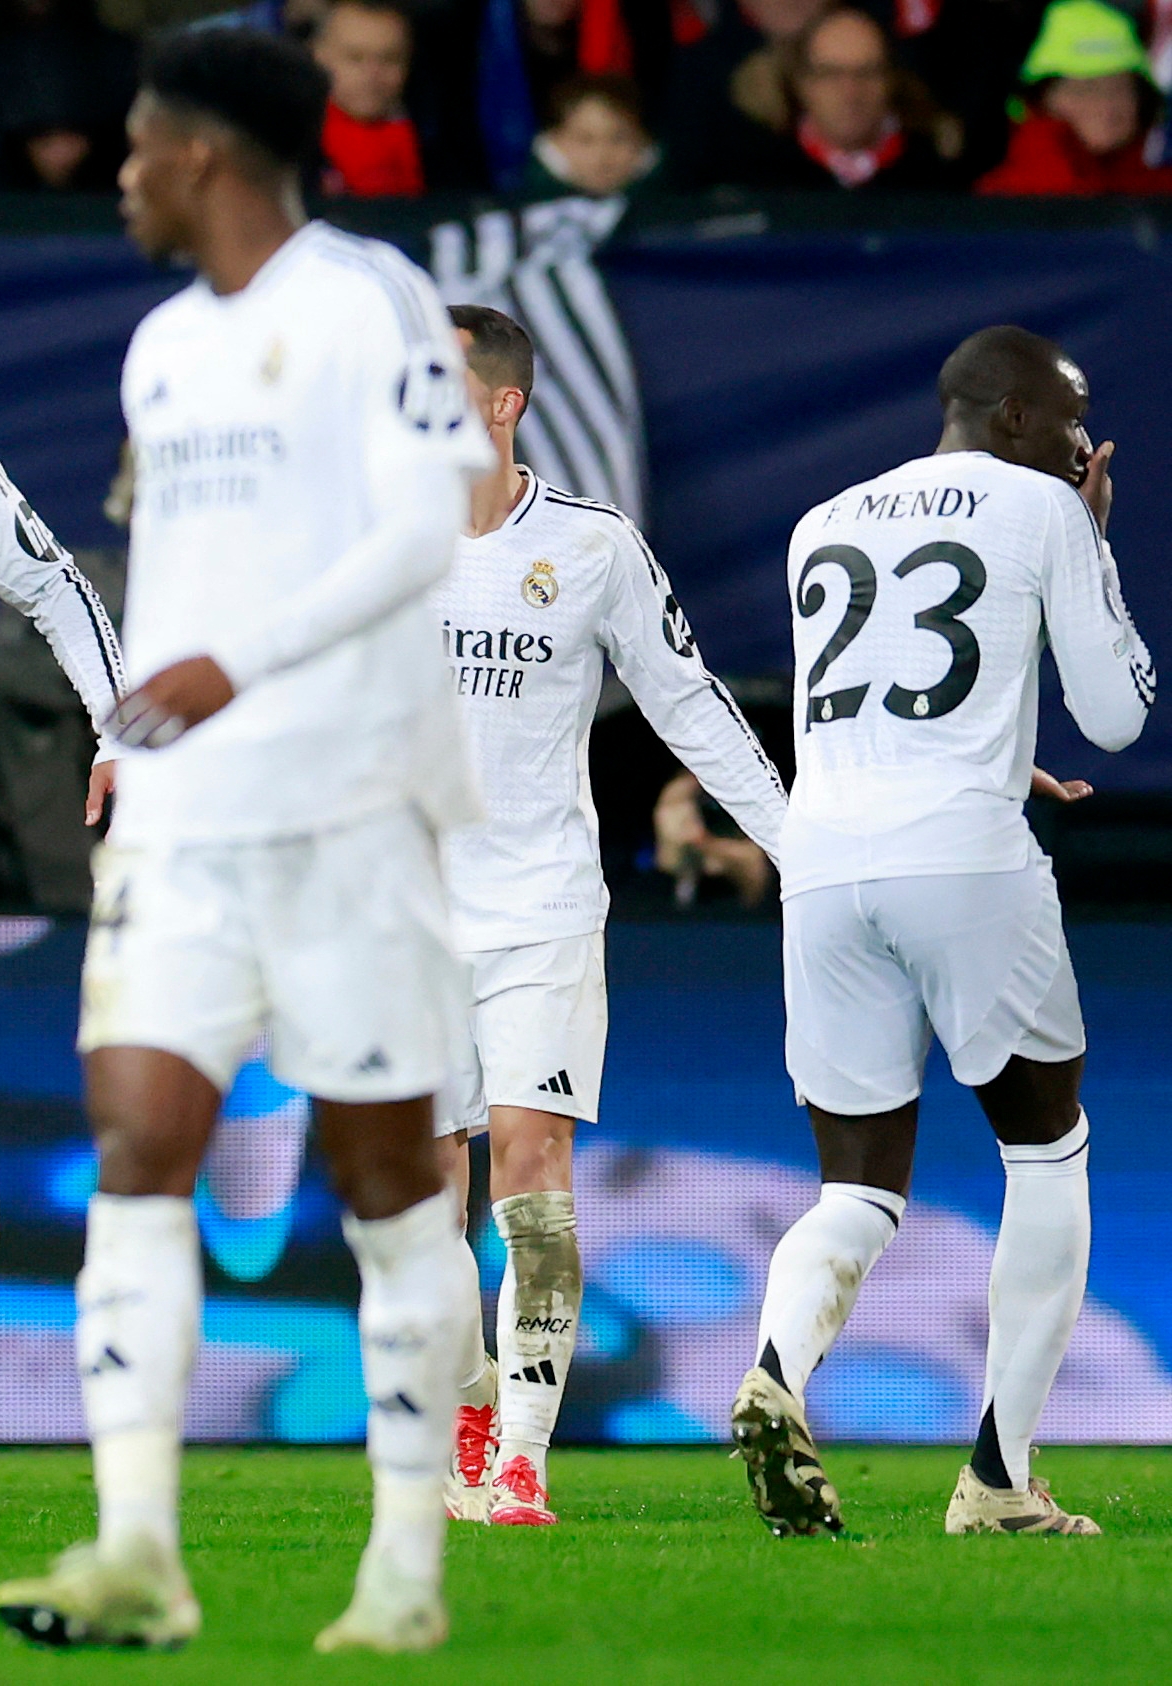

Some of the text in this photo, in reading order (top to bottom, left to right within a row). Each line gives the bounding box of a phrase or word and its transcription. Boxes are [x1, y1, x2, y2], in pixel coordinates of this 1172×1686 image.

[855, 487, 989, 520] MENDY
[796, 540, 987, 734] 23
[515, 1316, 573, 1333] RMCF
